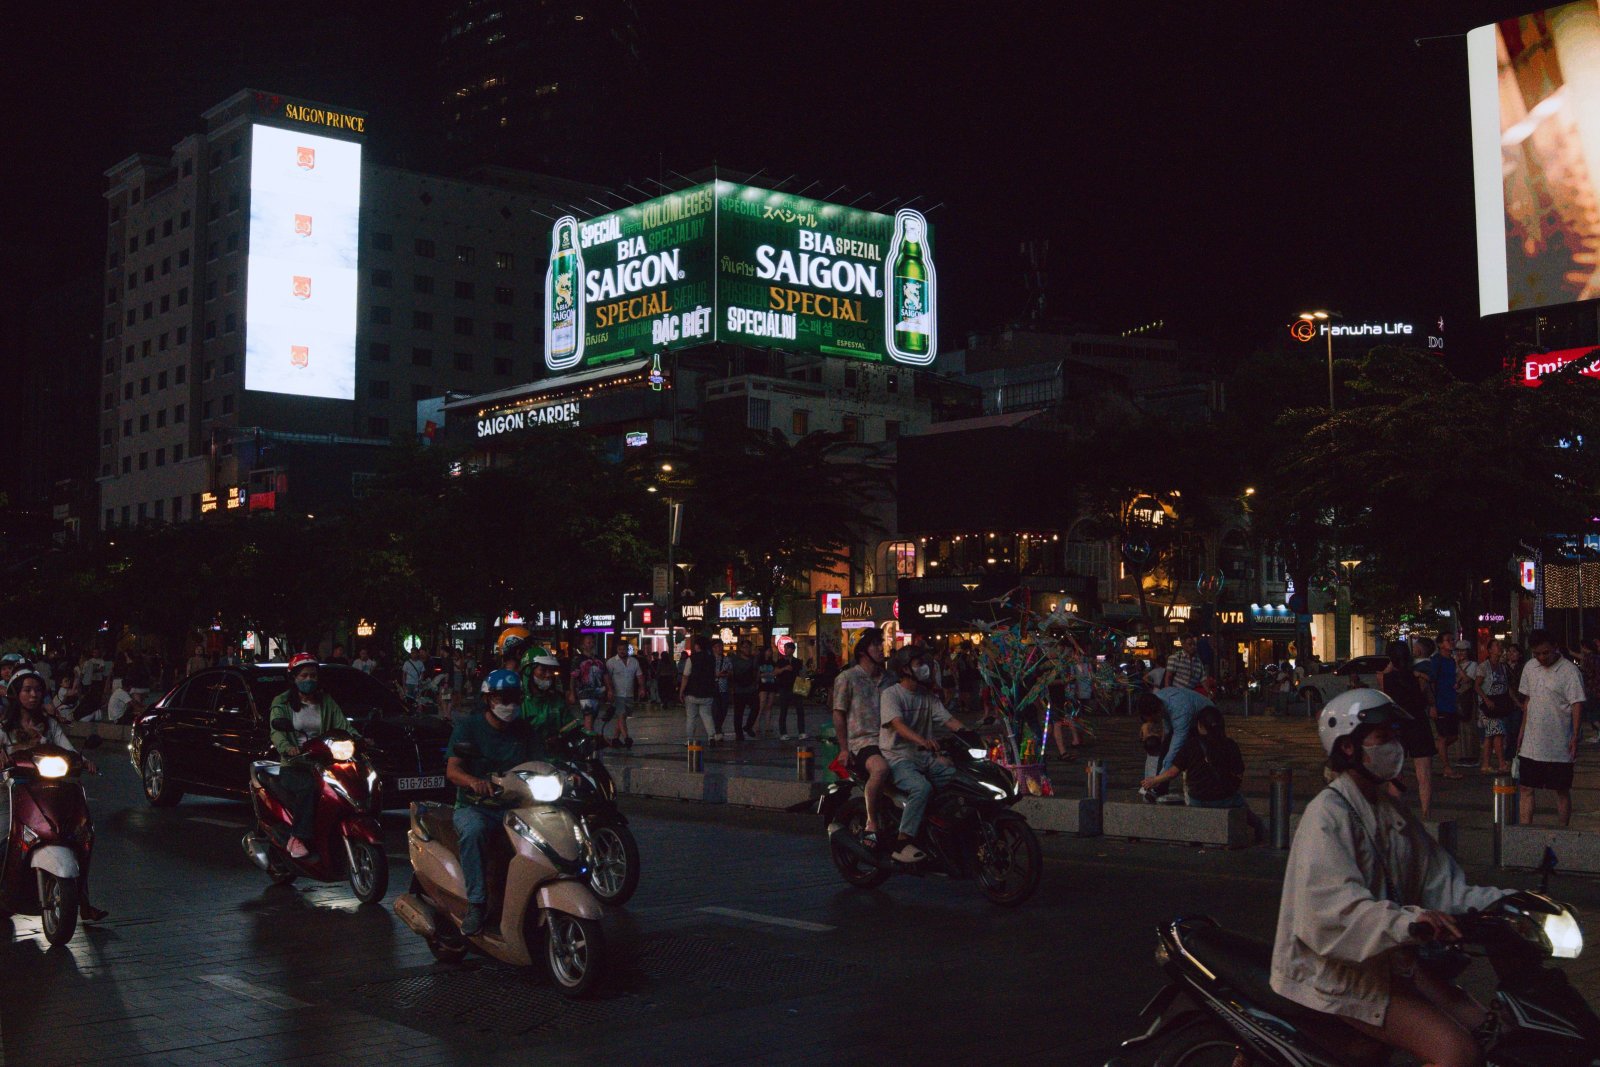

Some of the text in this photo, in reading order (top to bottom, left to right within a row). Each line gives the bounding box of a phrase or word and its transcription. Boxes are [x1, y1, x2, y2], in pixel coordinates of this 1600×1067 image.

[286, 103, 365, 132] SAIGON PRINCE
[763, 205, 818, 228] スペシャル
[617, 235, 647, 261] BIA
[798, 229, 837, 256] BIA
[836, 236, 882, 262] SPEZIAL
[586, 248, 681, 303] SAIGON
[755, 244, 877, 298] SAIGON
[595, 290, 673, 329] SPECIAL
[681, 304, 712, 339] BIỆT
[769, 285, 868, 323] SPECIAL
[727, 305, 797, 341] SPECIÁLNÍ
[1320, 323, 1413, 336] Hanwha Life
[477, 402, 580, 438] SAIGON GARDEN
